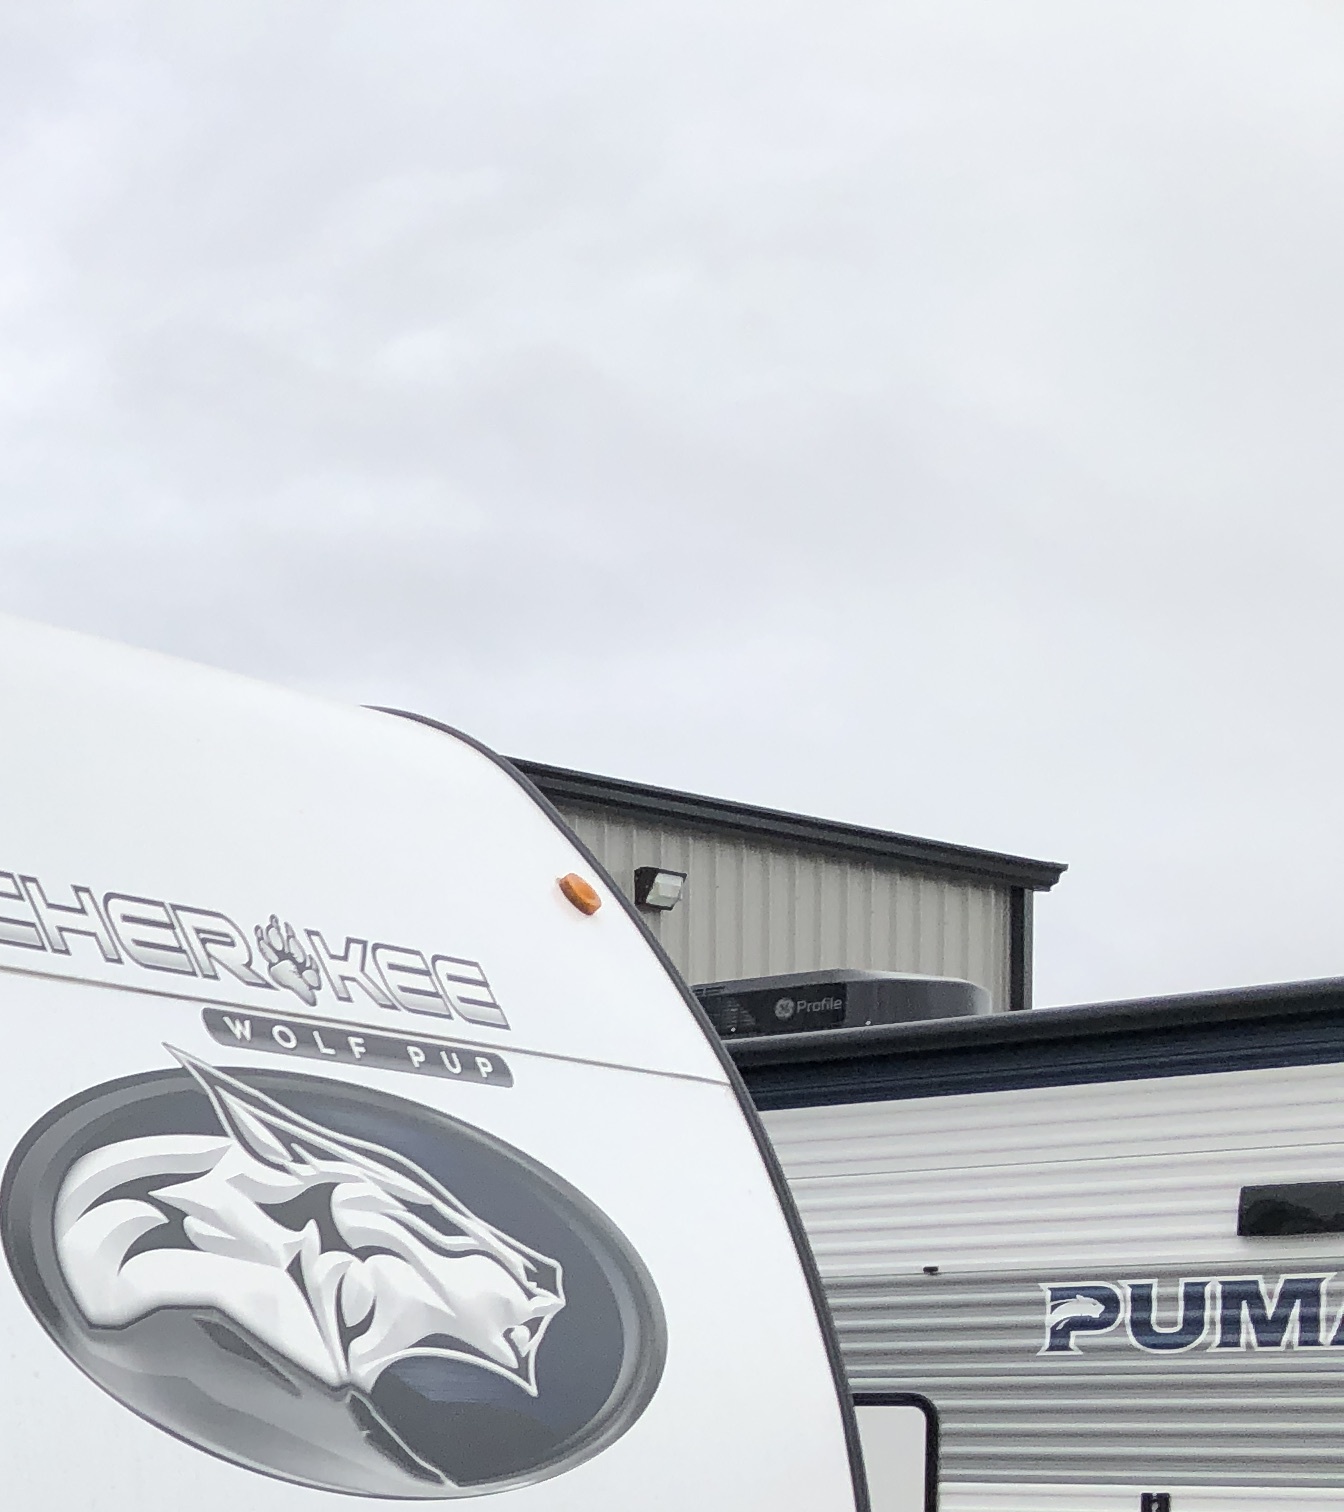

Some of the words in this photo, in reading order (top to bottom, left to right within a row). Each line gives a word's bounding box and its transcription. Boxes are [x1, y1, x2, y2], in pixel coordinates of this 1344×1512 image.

[796, 996, 843, 1013] Profile
[222, 1014, 369, 1060] WOLF
[406, 1044, 495, 1079] PUP
[1036, 1272, 1344, 1357] PUM
